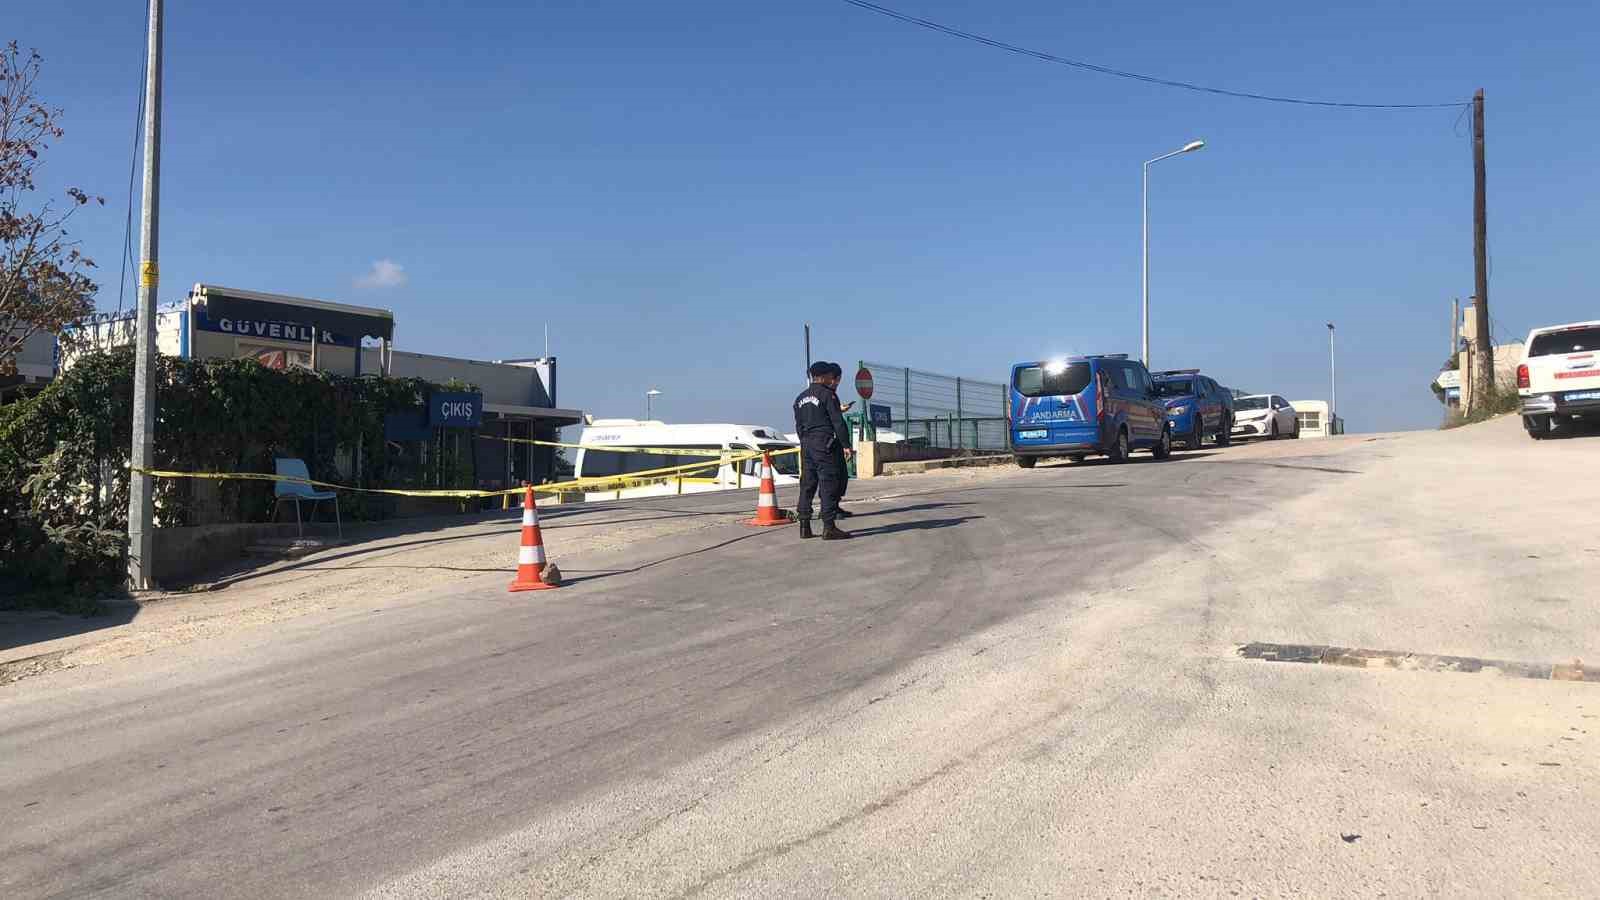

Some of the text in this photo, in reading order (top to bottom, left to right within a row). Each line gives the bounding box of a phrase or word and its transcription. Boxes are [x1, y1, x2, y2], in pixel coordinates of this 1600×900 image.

[219, 318, 334, 343] GÜVENLK
[441, 401, 473, 420] ÇIKIŞ
[1031, 409, 1078, 420] JANDARMA
